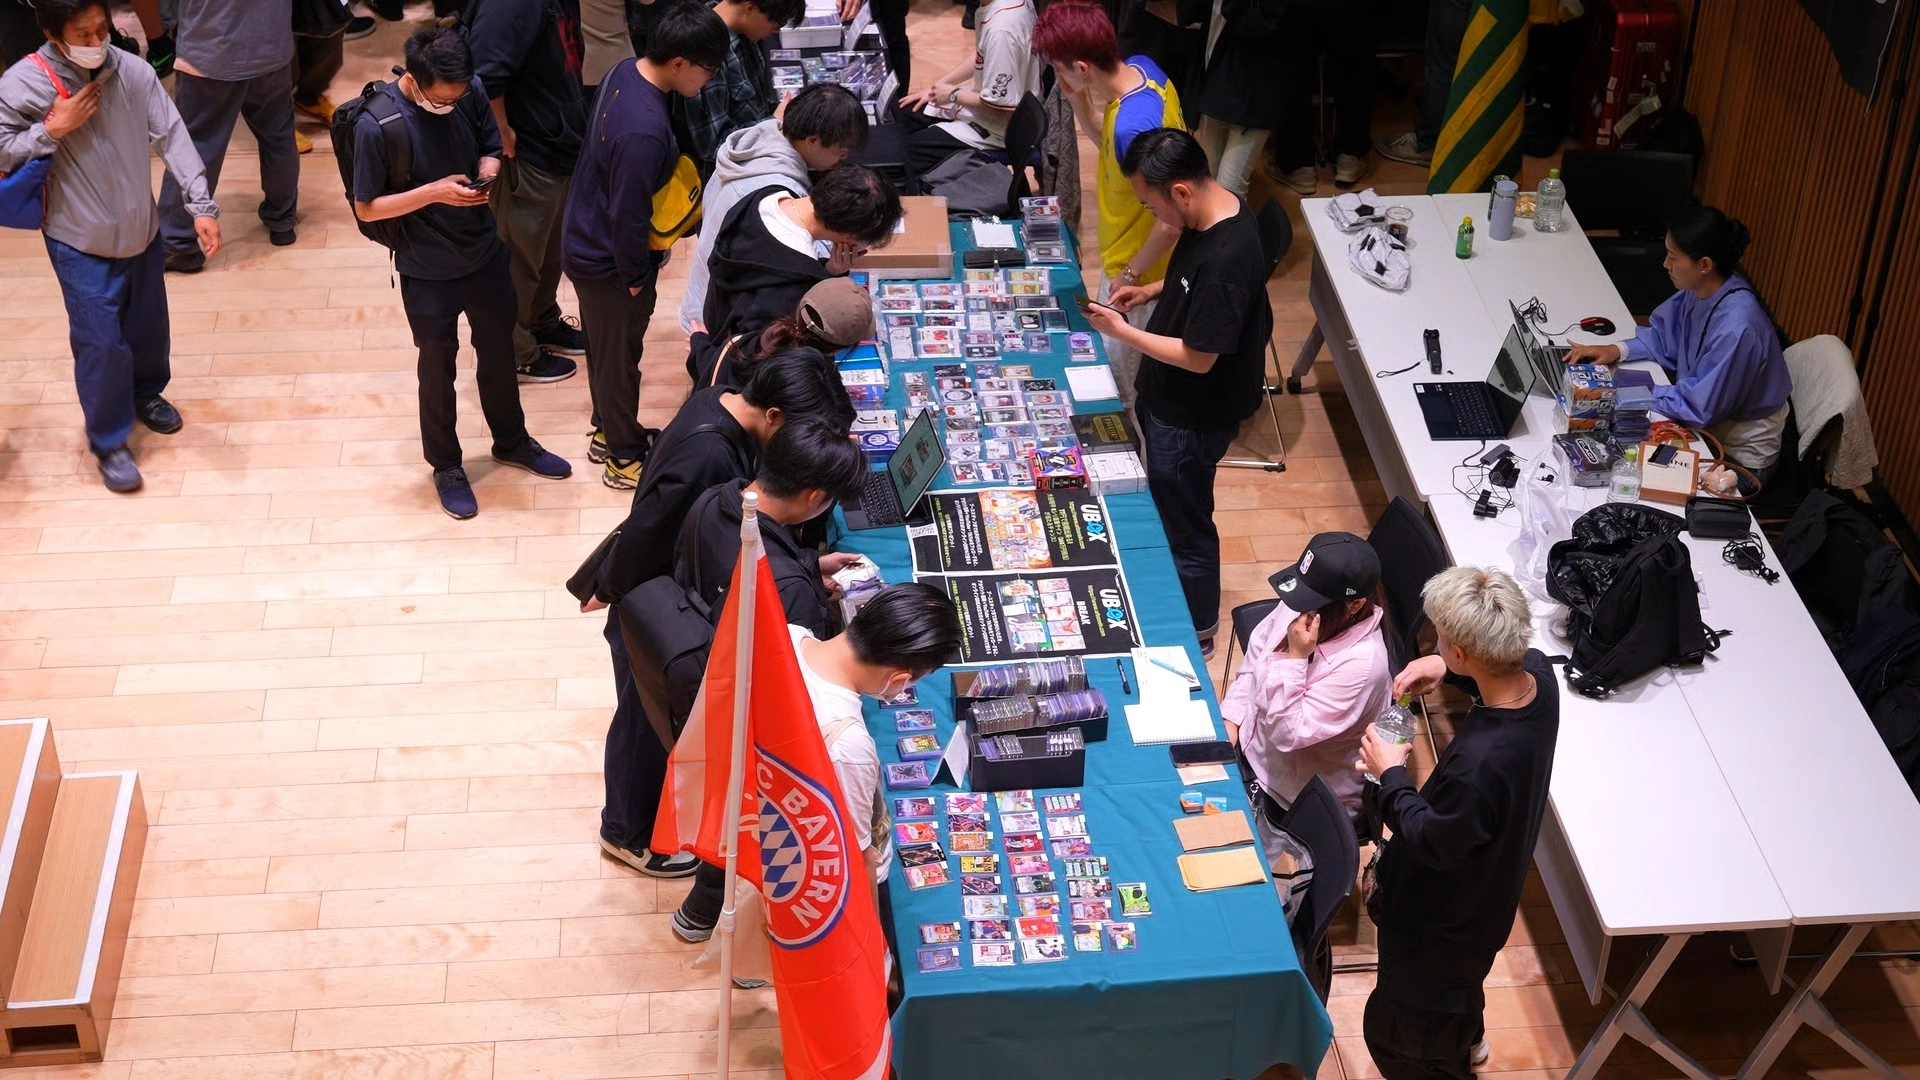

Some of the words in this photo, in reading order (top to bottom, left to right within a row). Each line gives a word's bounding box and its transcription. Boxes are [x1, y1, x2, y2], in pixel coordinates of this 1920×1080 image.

[1080, 504, 1108, 543] UBOX
[1076, 600, 1091, 625] BREAK
[1099, 588, 1128, 631] UBOX
[780, 787, 840, 929] BAYERN
